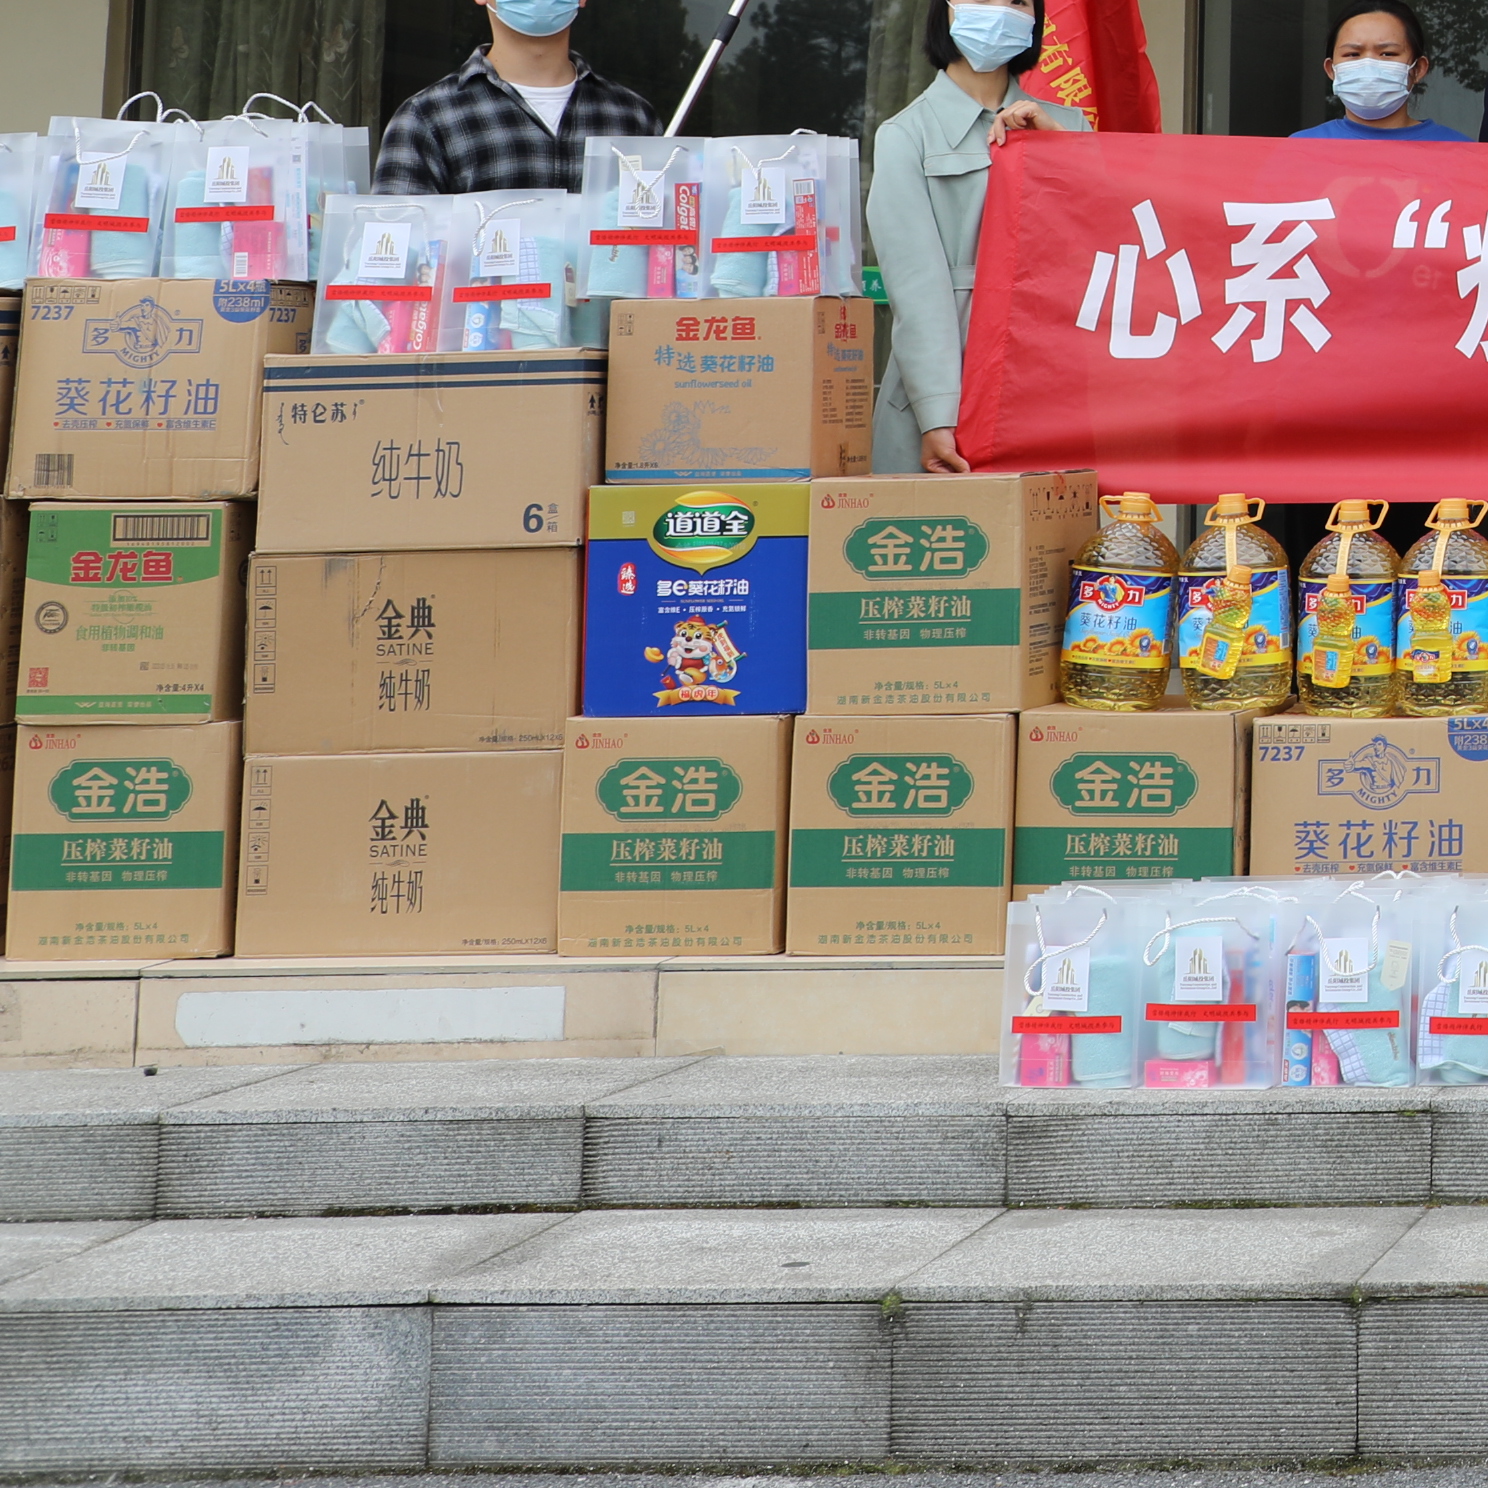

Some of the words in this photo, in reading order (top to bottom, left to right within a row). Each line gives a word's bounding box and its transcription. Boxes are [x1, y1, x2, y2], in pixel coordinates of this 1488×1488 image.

[679, 184, 692, 230] Colgat
[31, 306, 75, 320] 7237
[218, 297, 264, 309] 附238ml
[269, 308, 297, 323] 7237
[675, 316, 756, 342] 金龙鱼
[120, 347, 160, 363] MIGHTY
[674, 379, 740, 389] sunflowerseed
[742, 379, 753, 388] oil
[55, 378, 220, 416] 葵花籽油
[291, 402, 347, 424] 特仑苏
[371, 437, 464, 500] 纯牛奶
[837, 498, 869, 509] JINHAO
[523, 503, 544, 533] 6
[666, 510, 749, 537] 道道全
[867, 525, 966, 572] 金浩
[70, 550, 173, 583] 金龙鱼
[859, 596, 972, 619] 压榨菜籽油
[1097, 598, 1121, 611] MIGHTY
[375, 597, 436, 641] 金典
[1079, 612, 1138, 630] 葵花籽油
[75, 625, 164, 641] 食用植物调和油
[863, 629, 910, 640] 非转基因
[919, 627, 967, 639] 物理压榨
[376, 642, 434, 657] SATINE
[378, 668, 430, 712] 纯牛奶
[45, 738, 76, 750] JINHAO
[591, 737, 624, 749] JINHAO
[822, 733, 855, 745] JINHAO
[1045, 730, 1078, 742] JINHAO
[1258, 746, 1305, 762] 7237
[71, 767, 169, 814] 金浩
[620, 765, 719, 813] 金浩
[851, 761, 950, 809] 金浩
[1074, 760, 1173, 808] 金浩
[1356, 788, 1399, 806] MIGHTY
[369, 798, 429, 841] 金典
[61, 838, 173, 861] 压榨菜籽油
[369, 844, 427, 858] SATINE
[610, 838, 723, 862] 压榨菜籽油
[842, 834, 955, 858] 压榨菜籽油
[1065, 833, 1179, 857] 压榨菜籽油
[1293, 820, 1463, 860] 葵花籽油
[66, 871, 112, 882] 非转基因
[121, 870, 168, 882] 物理压榨
[614, 870, 661, 883] 非转基因
[671, 870, 718, 883] 物理压榨
[845, 866, 893, 879] 非转基因
[902, 866, 949, 879] 物理压榨
[1069, 866, 1116, 878] 非转基因
[1126, 865, 1174, 878] 物理压榨
[370, 870, 423, 914] 纯牛奶
